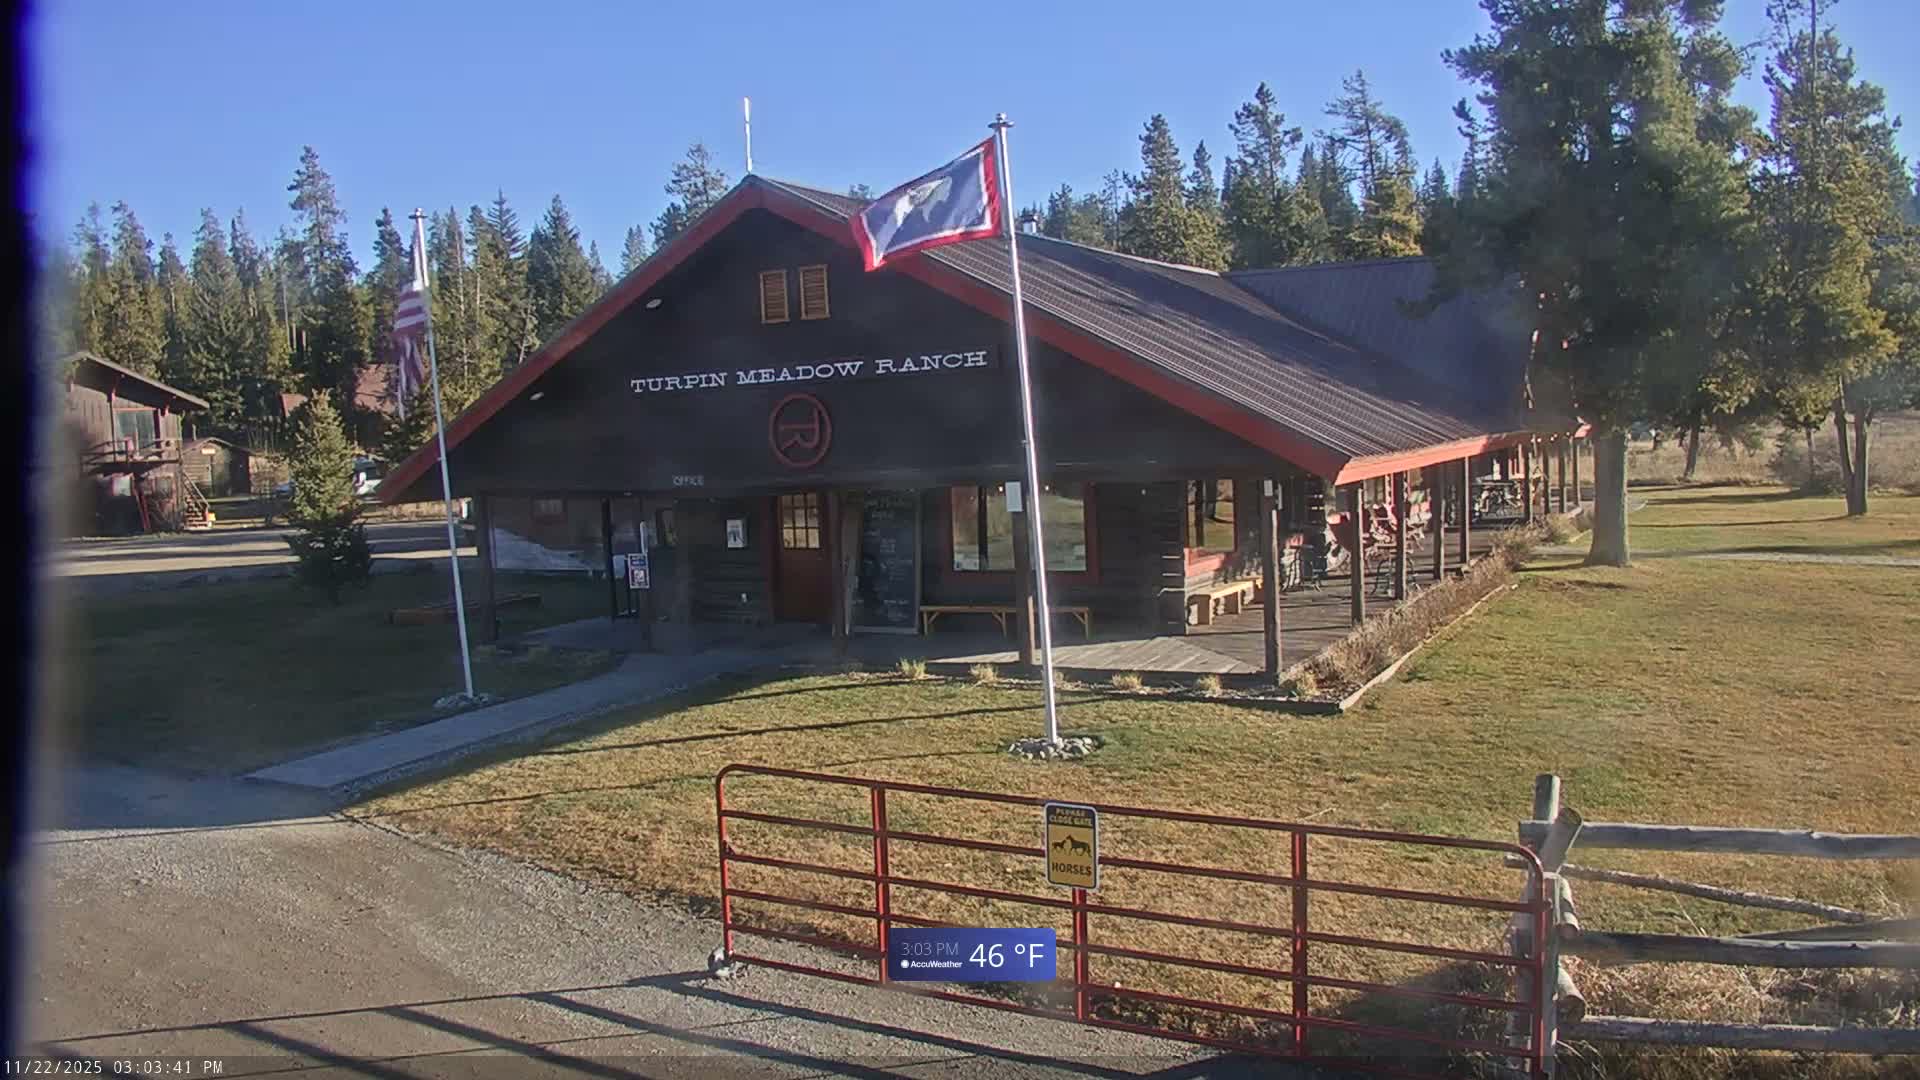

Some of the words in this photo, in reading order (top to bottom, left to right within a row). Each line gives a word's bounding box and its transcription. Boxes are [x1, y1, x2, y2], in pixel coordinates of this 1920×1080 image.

[631, 372, 727, 393] TURPIN
[737, 361, 864, 385] MEADOW
[875, 351, 988, 374] RANCH
[1051, 862, 1092, 877] HORSES
